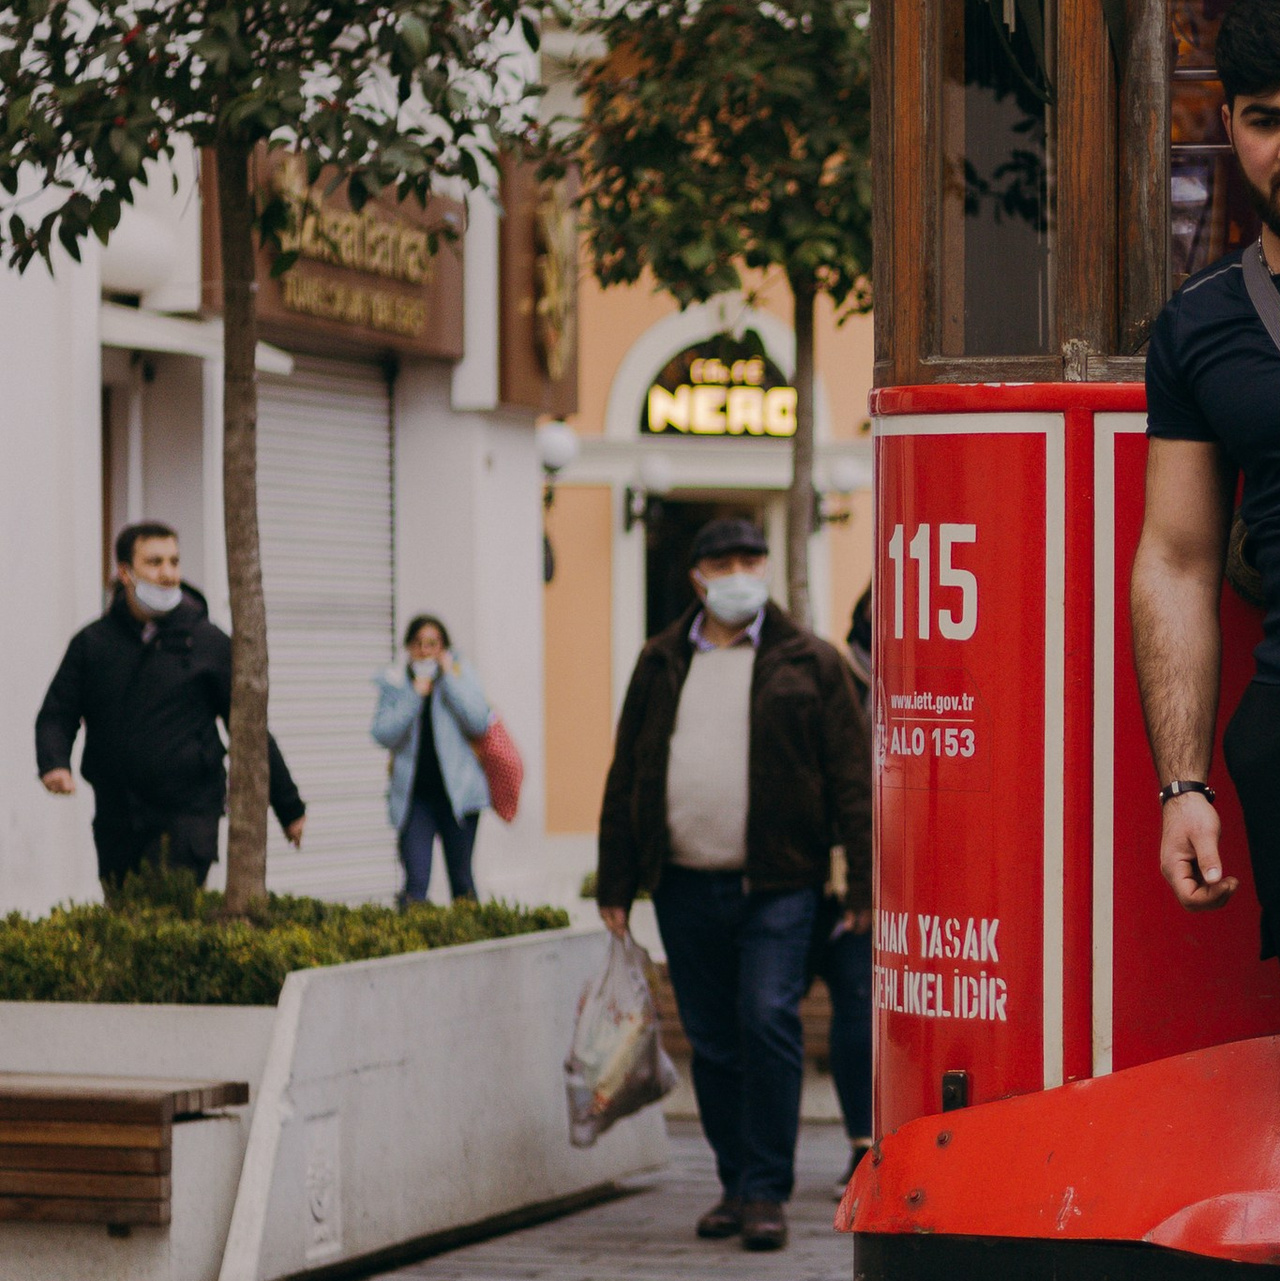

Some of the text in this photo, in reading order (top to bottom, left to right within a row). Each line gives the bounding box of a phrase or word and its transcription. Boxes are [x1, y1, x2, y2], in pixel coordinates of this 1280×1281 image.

[888, 523, 978, 641] 115
[890, 691, 975, 715] www.iett.gov.tr
[890, 726, 976, 758] ALO 153
[917, 913, 1000, 963] YASAK
